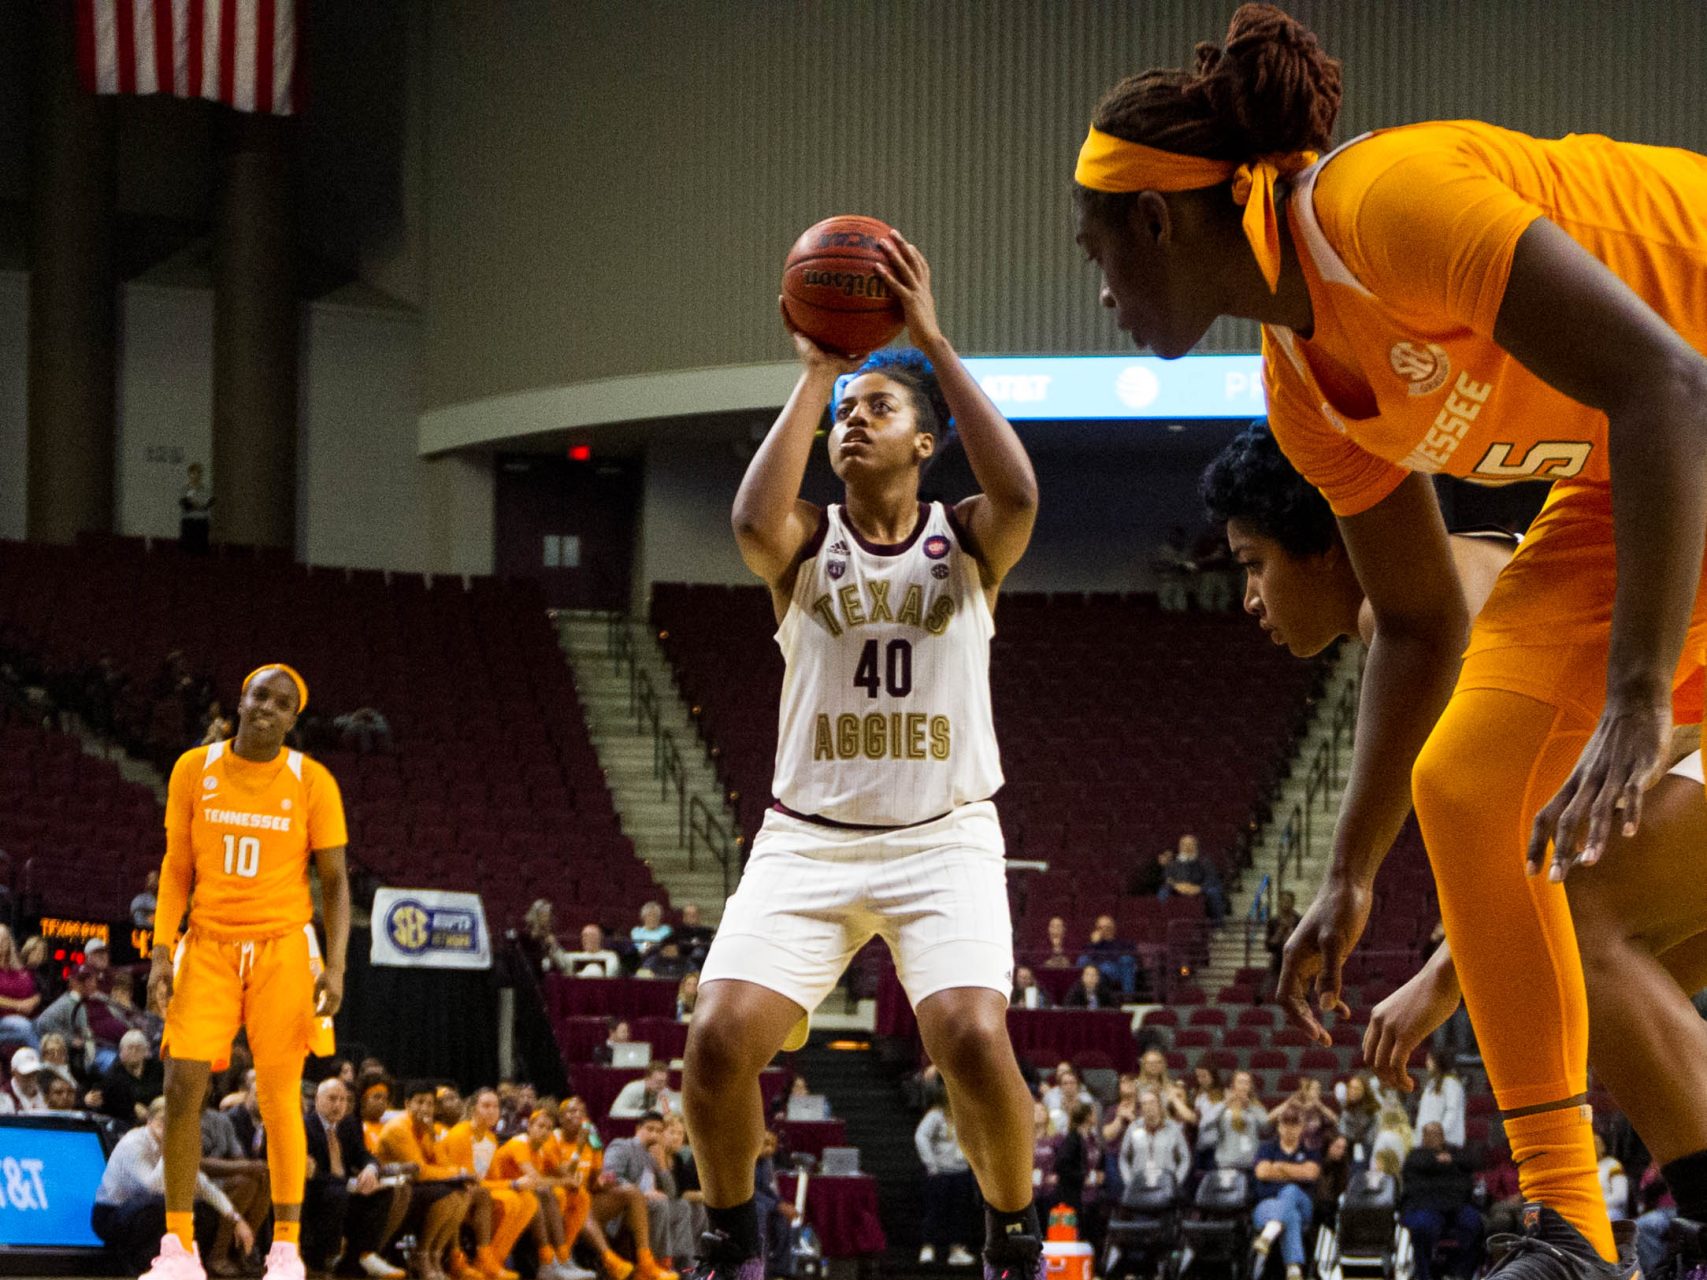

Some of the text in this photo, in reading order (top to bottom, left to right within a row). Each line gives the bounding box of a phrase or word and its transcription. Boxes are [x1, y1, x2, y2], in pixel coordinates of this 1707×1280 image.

[1473, 440, 1593, 478] 5
[812, 580, 956, 637] TEXAS
[854, 639, 912, 698] 40
[813, 712, 951, 761] AGGIES
[204, 808, 292, 832] TENNESSEE
[223, 834, 260, 878] 10
